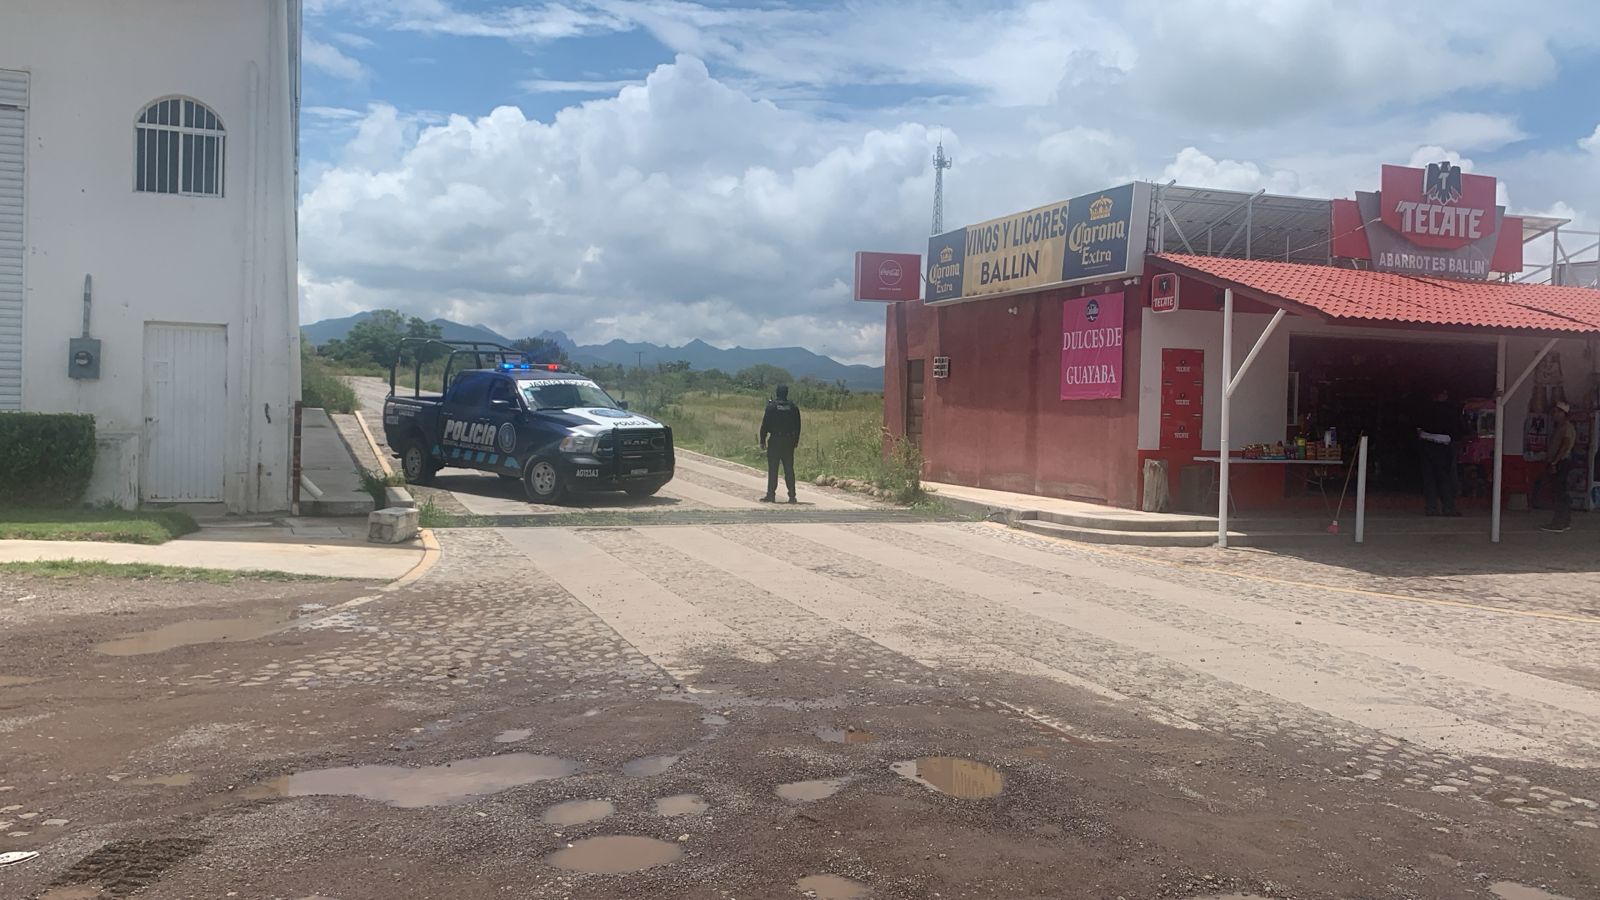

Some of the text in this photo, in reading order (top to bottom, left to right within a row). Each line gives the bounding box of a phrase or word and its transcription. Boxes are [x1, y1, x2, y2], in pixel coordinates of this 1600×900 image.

[966, 206, 1068, 257] VINOS Y LICORES
[1395, 200, 1485, 239] TECATE
[1069, 219, 1126, 254] Corona
[980, 250, 1040, 285] BALLIN
[1081, 246, 1112, 265] Extra
[1449, 258, 1485, 275] BALLIN
[929, 261, 960, 286] Corona
[936, 278, 953, 294] Extra
[1153, 296, 1175, 307] TECATE
[1063, 327, 1123, 351] DULCES DE
[1066, 364, 1117, 385] GUAYABA
[443, 419, 497, 445] POLICÍA
